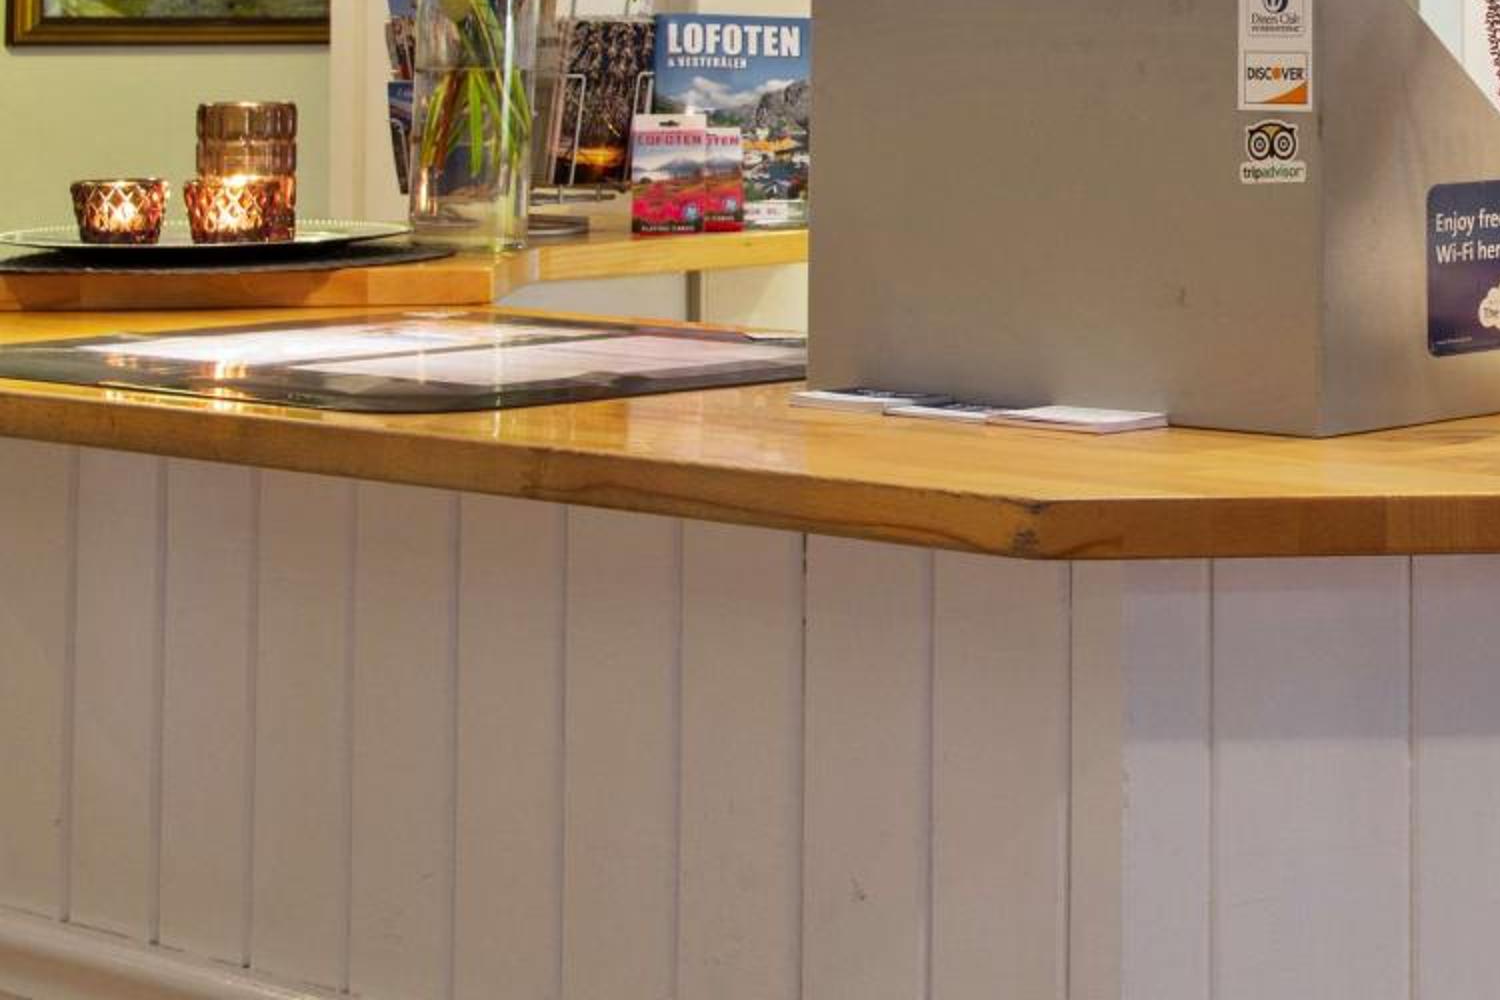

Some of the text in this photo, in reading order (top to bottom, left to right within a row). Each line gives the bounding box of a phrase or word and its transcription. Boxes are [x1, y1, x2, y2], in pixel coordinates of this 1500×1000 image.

[667, 23, 800, 56] LOFOTEN
[1247, 67, 1304, 81] DISCOVER
[638, 134, 702, 146] LOFOTEN
[1243, 165, 1299, 180] tripadvisor
[1435, 211, 1475, 237] Enjoy
[1435, 241, 1474, 264] Wi-Fi
